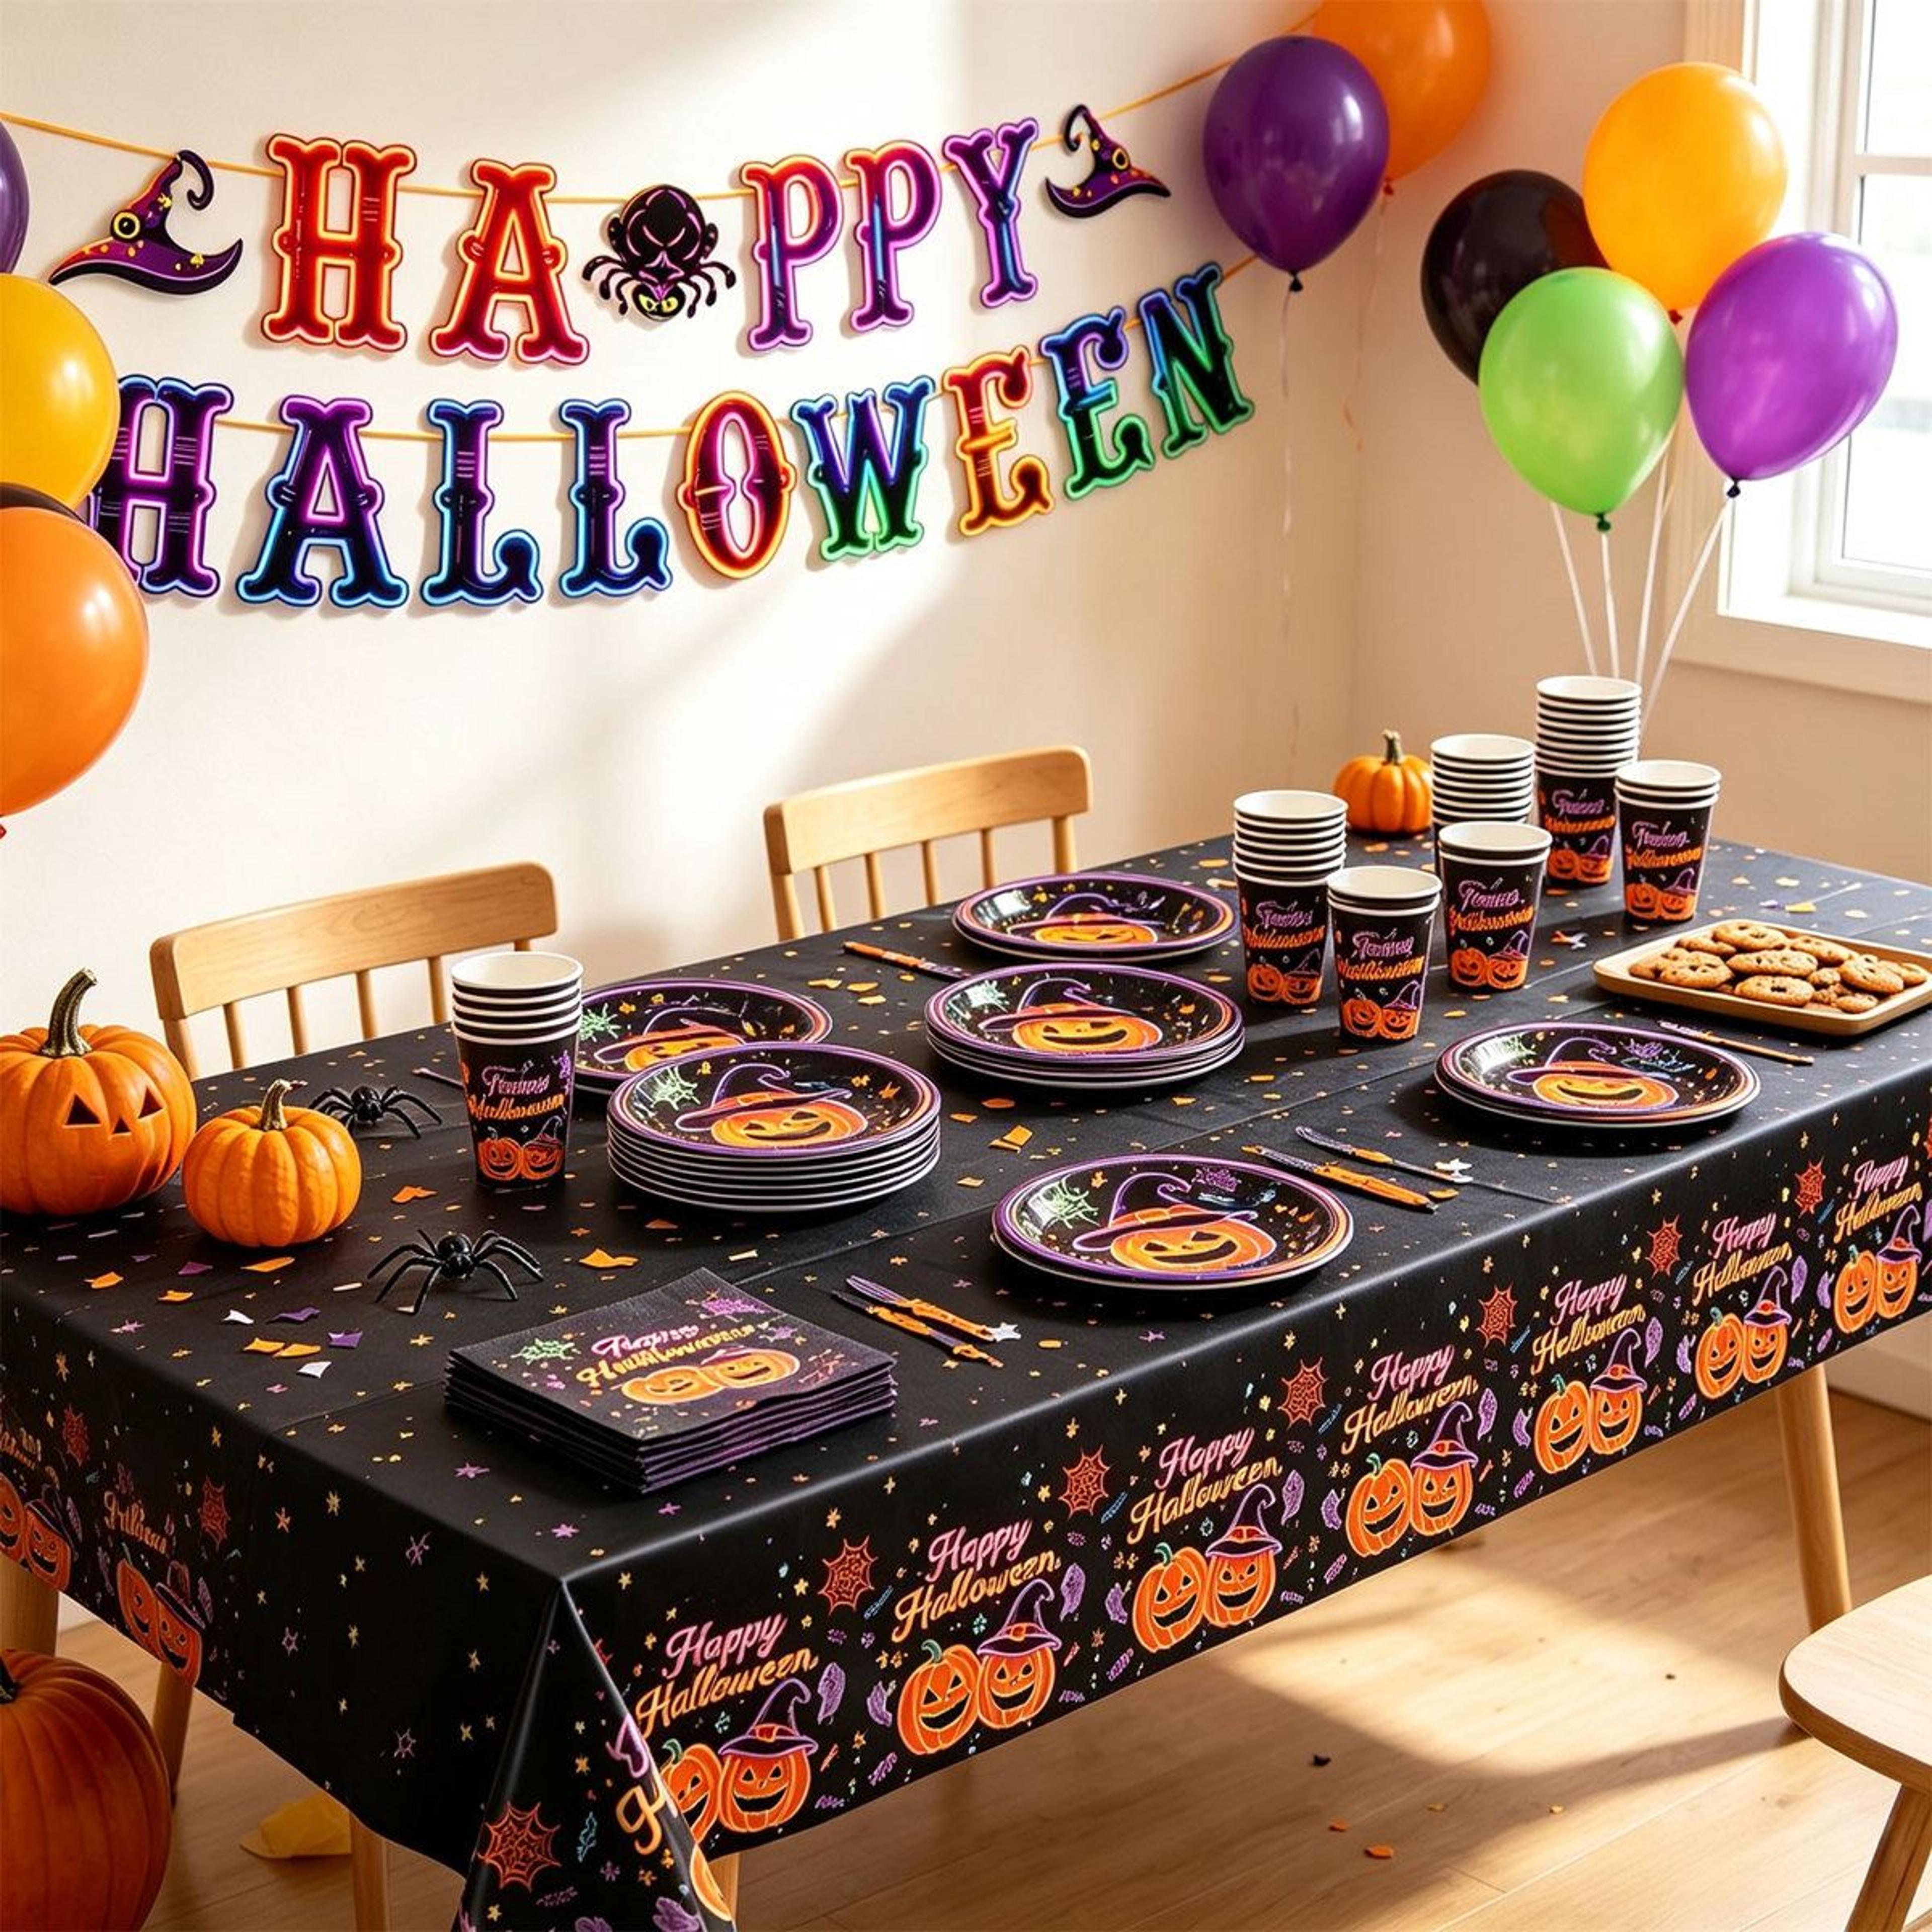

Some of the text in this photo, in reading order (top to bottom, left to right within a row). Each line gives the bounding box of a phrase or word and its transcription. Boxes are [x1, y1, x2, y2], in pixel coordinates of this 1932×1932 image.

[88, 263, 1255, 607] HALLOWEEN
[925, 1518, 1032, 1582] Happy
[662, 1613, 788, 1679] Happy
